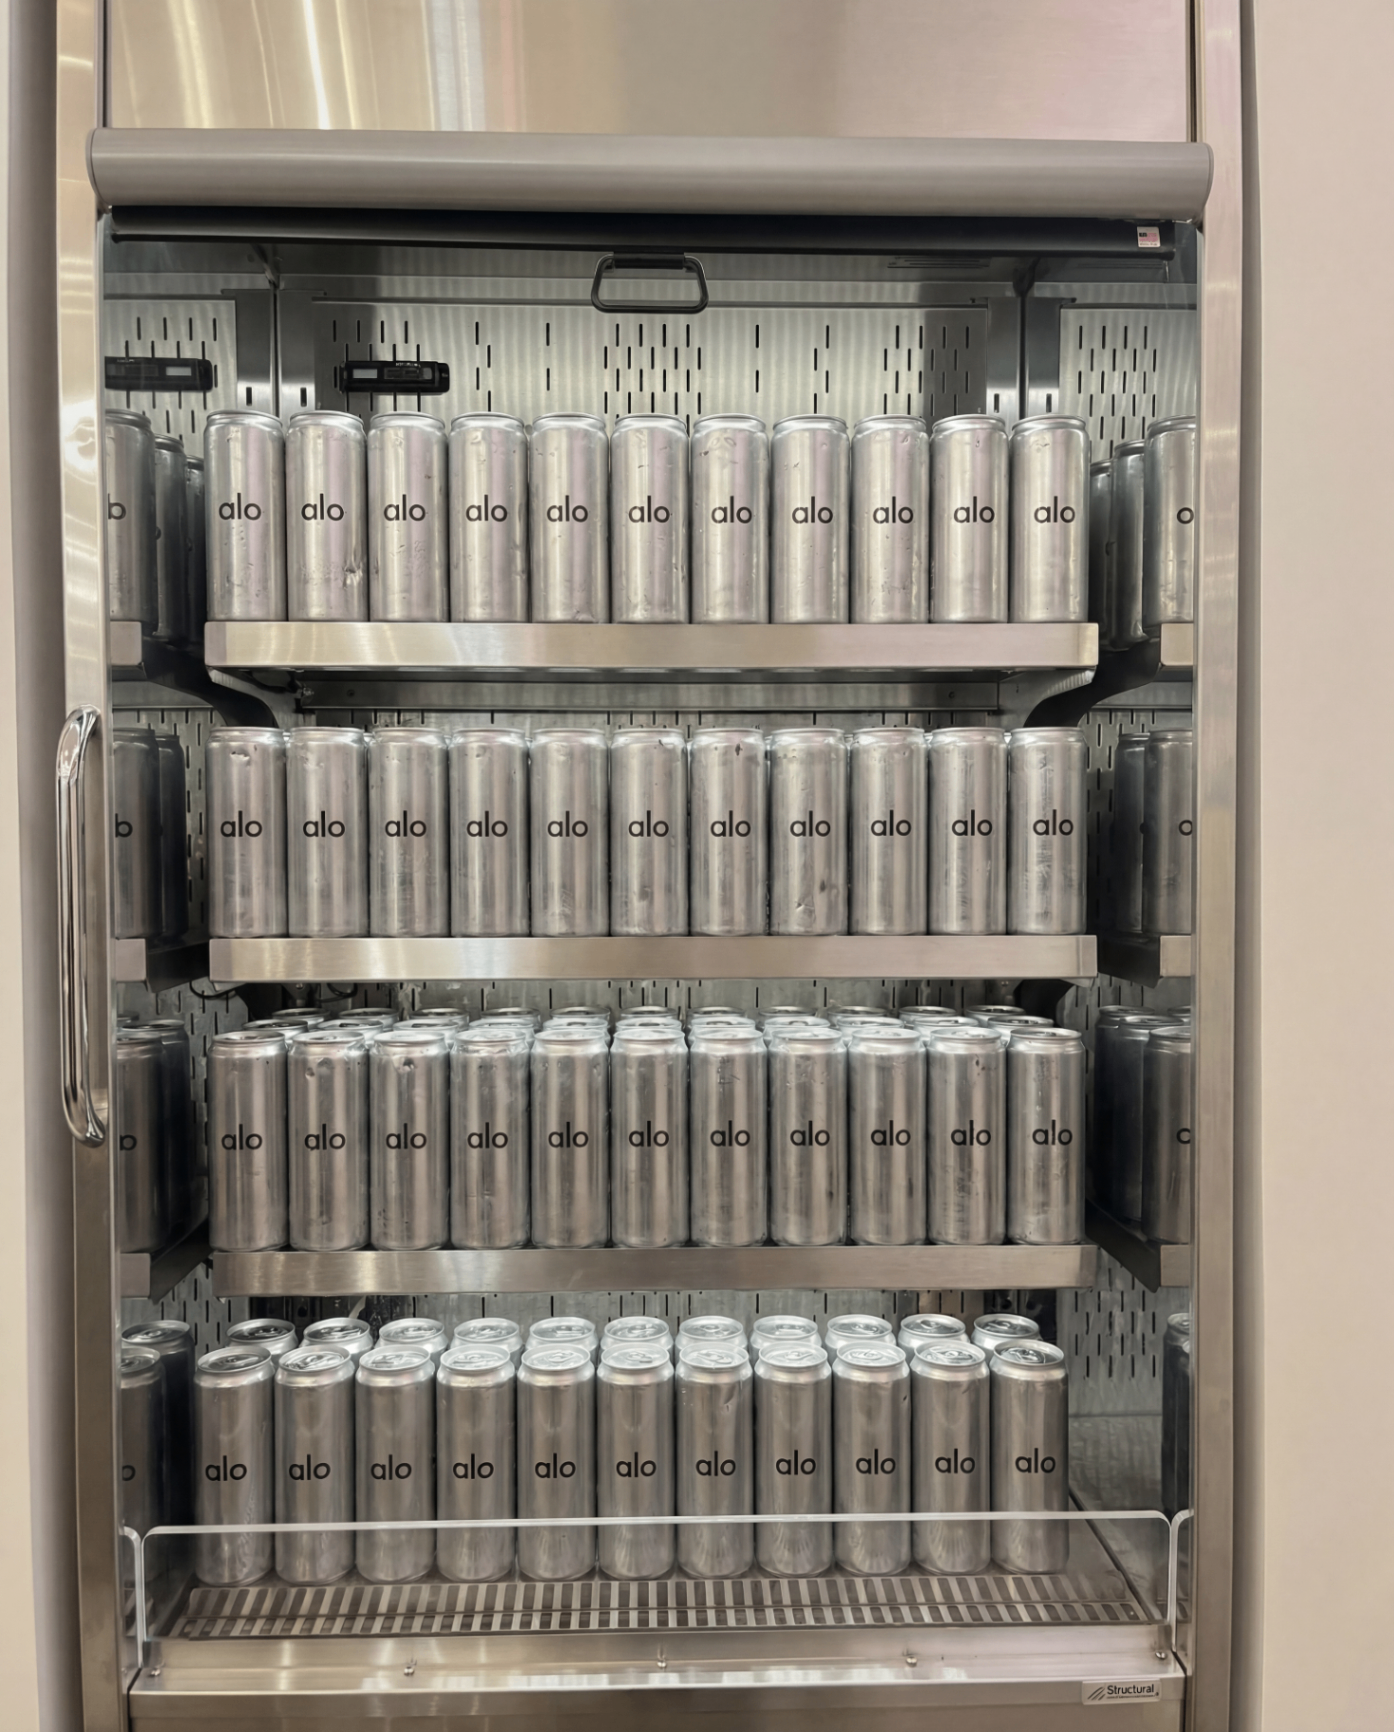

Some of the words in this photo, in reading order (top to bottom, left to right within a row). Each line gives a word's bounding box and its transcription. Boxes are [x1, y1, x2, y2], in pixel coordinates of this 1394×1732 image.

[219, 493, 261, 520] alo
[301, 493, 344, 521] alo
[384, 494, 426, 521] alo
[466, 494, 508, 522] alo
[547, 495, 588, 522] alo
[629, 495, 670, 523] alo
[711, 495, 753, 524] alo
[792, 496, 833, 524] alo
[873, 496, 913, 524] alo
[954, 496, 995, 523] alo
[1034, 496, 1075, 523] alo
[221, 810, 262, 837] alo
[303, 811, 345, 837] alo
[385, 810, 427, 837] alo
[467, 811, 508, 837] alo
[548, 811, 588, 837] alo
[629, 810, 669, 837] alo
[710, 810, 751, 837] alo
[790, 810, 831, 837] alo
[871, 809, 912, 836] alo
[952, 809, 992, 836] alo
[1033, 809, 1073, 836] alo
[222, 1124, 262, 1150] alo
[305, 1124, 345, 1150] alo
[386, 1123, 427, 1149] alo
[468, 1122, 508, 1149] alo
[549, 1122, 588, 1148] alo
[629, 1121, 669, 1147] alo
[710, 1120, 750, 1146] alo
[790, 1121, 830, 1146] alo
[871, 1120, 911, 1146] alo
[951, 1120, 991, 1146] alo
[1032, 1120, 1072, 1145] alo
[206, 1455, 247, 1481] alo
[289, 1453, 330, 1480] alo
[371, 1454, 411, 1480] alo
[453, 1452, 494, 1479] alo
[535, 1452, 575, 1478] alo
[616, 1451, 656, 1477] alo
[696, 1450, 736, 1476] alo
[776, 1449, 816, 1475] alo
[856, 1448, 896, 1474] alo
[935, 1448, 975, 1473] alo
[1015, 1447, 1055, 1473] alo
[1107, 1684, 1155, 1695] Structural
